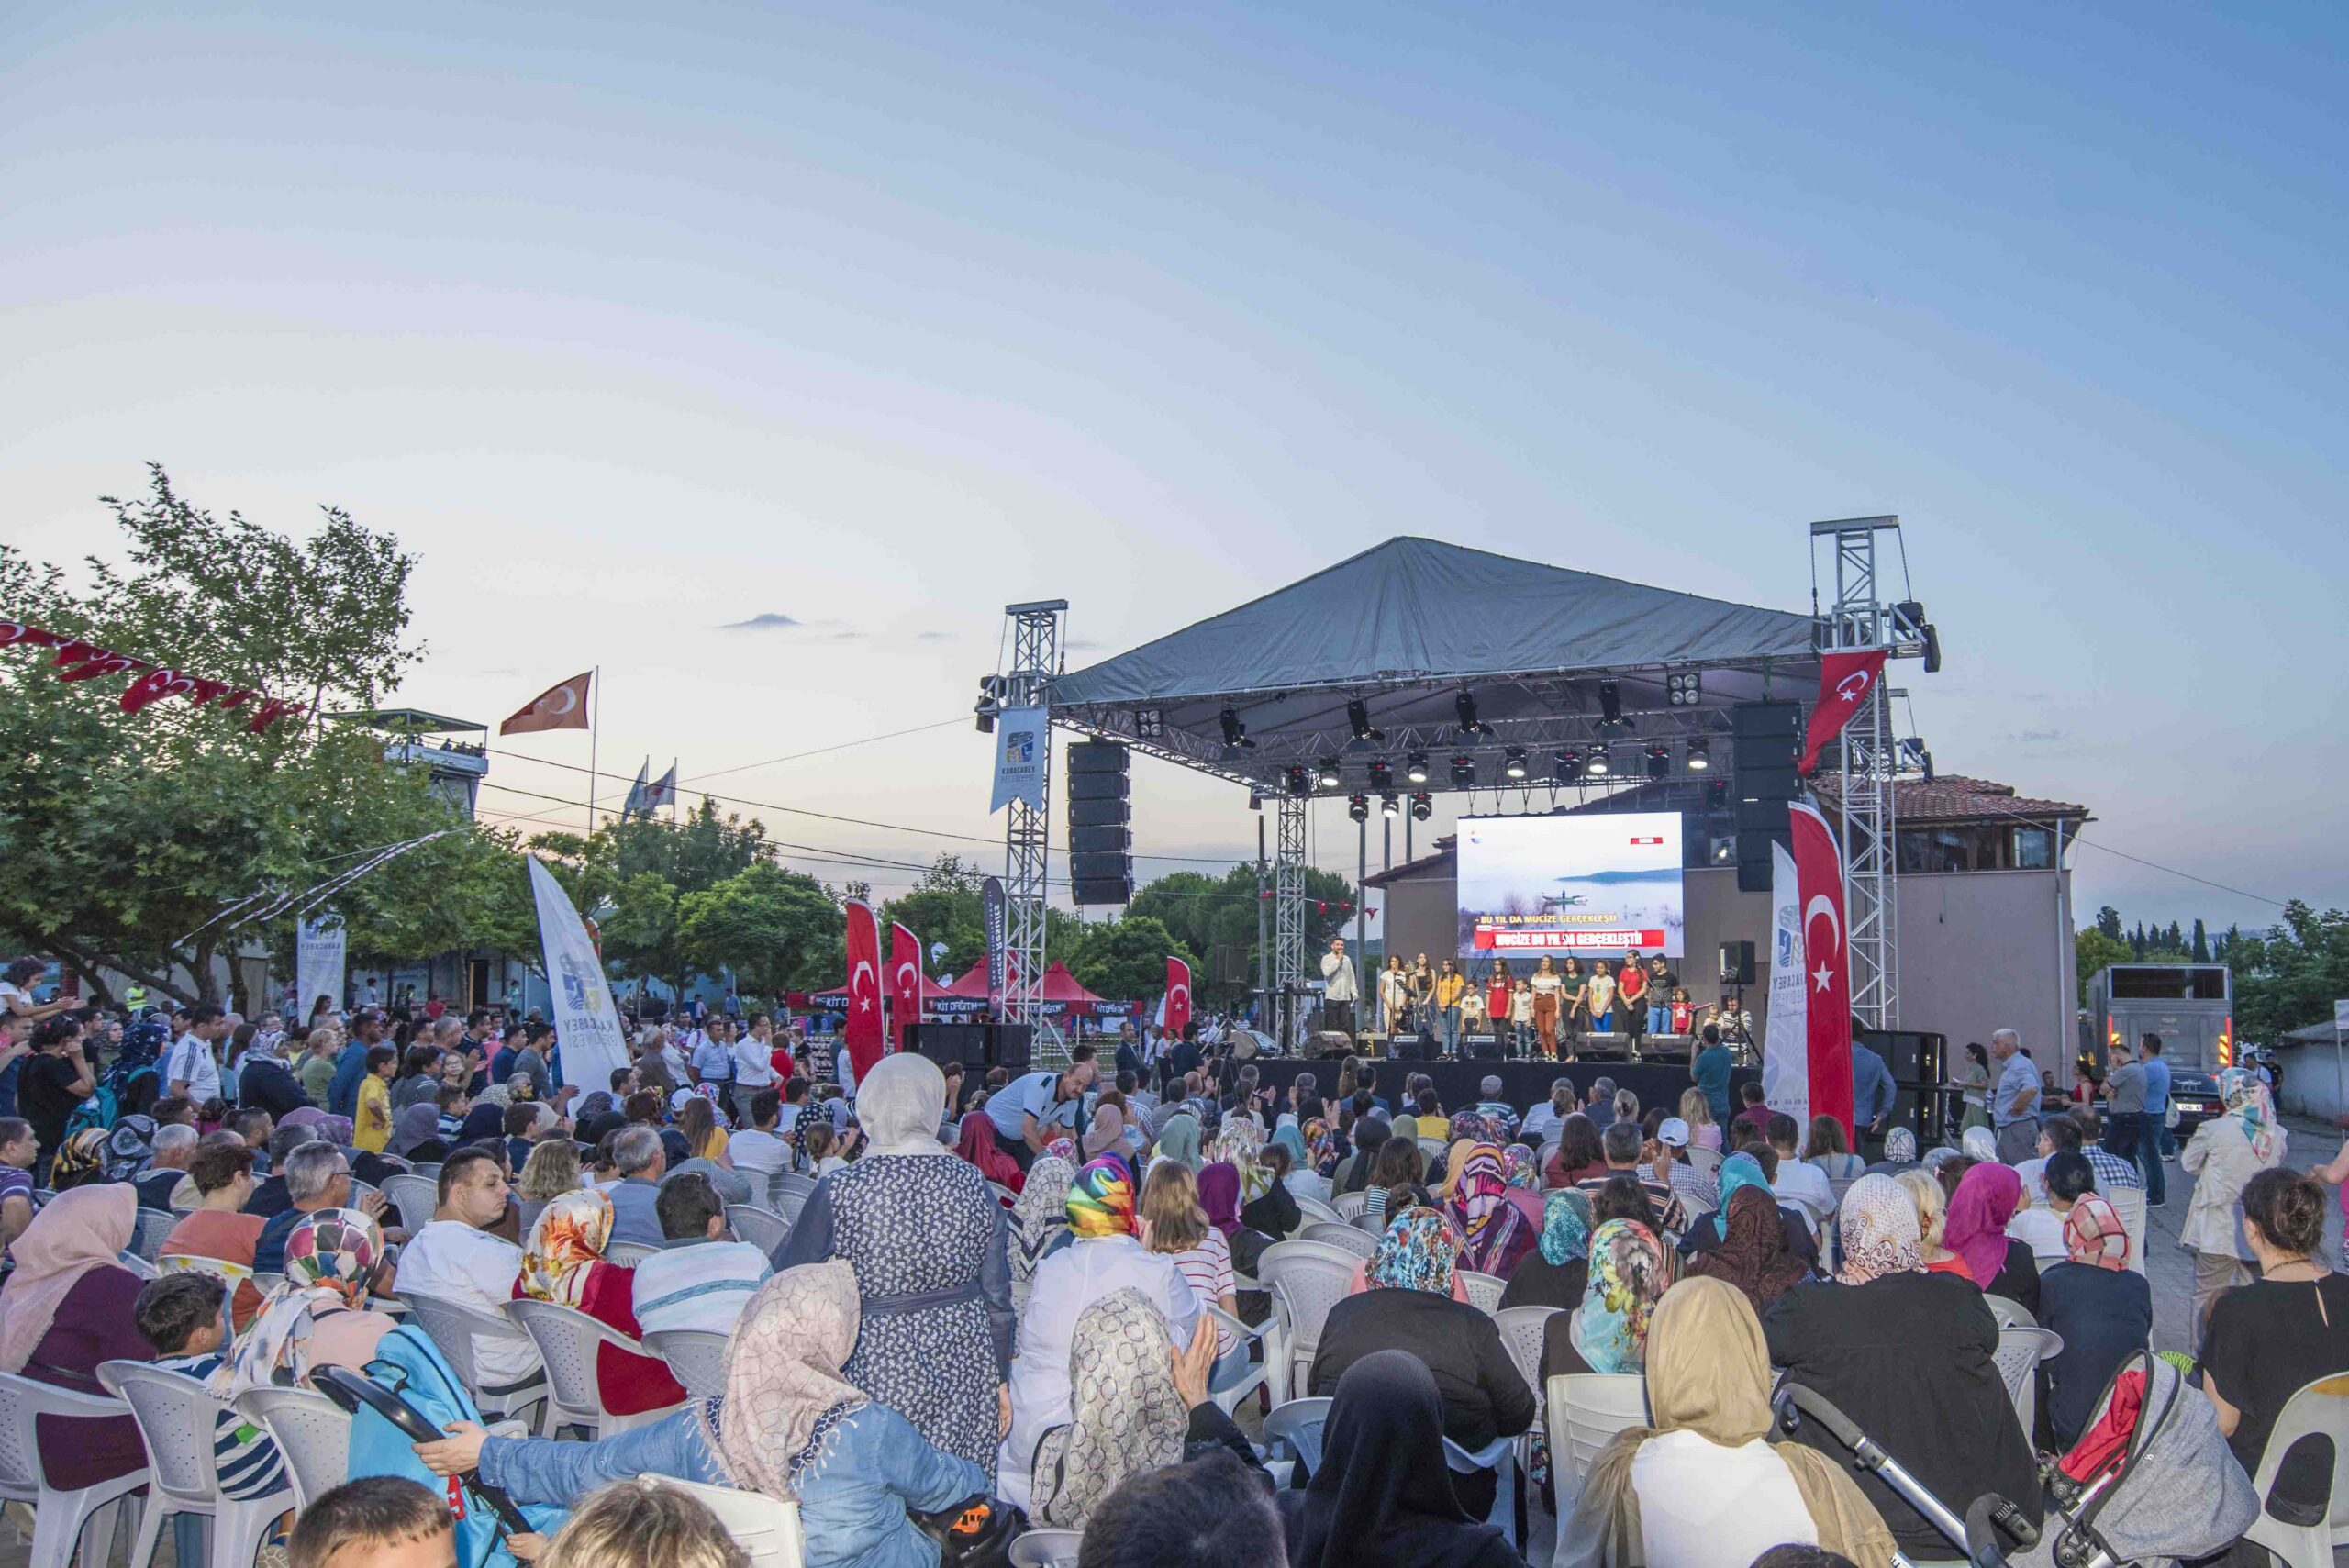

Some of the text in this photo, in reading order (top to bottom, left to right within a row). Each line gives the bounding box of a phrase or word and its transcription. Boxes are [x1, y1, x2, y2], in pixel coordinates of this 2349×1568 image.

[1001, 765, 1036, 774] KARACABEY
[1480, 916, 1493, 924] BU
[1495, 916, 1508, 924] YIL
[1509, 916, 1523, 924] DA
[1524, 914, 1557, 924] MUCİZE
[937, 1000, 949, 1012] KİT
